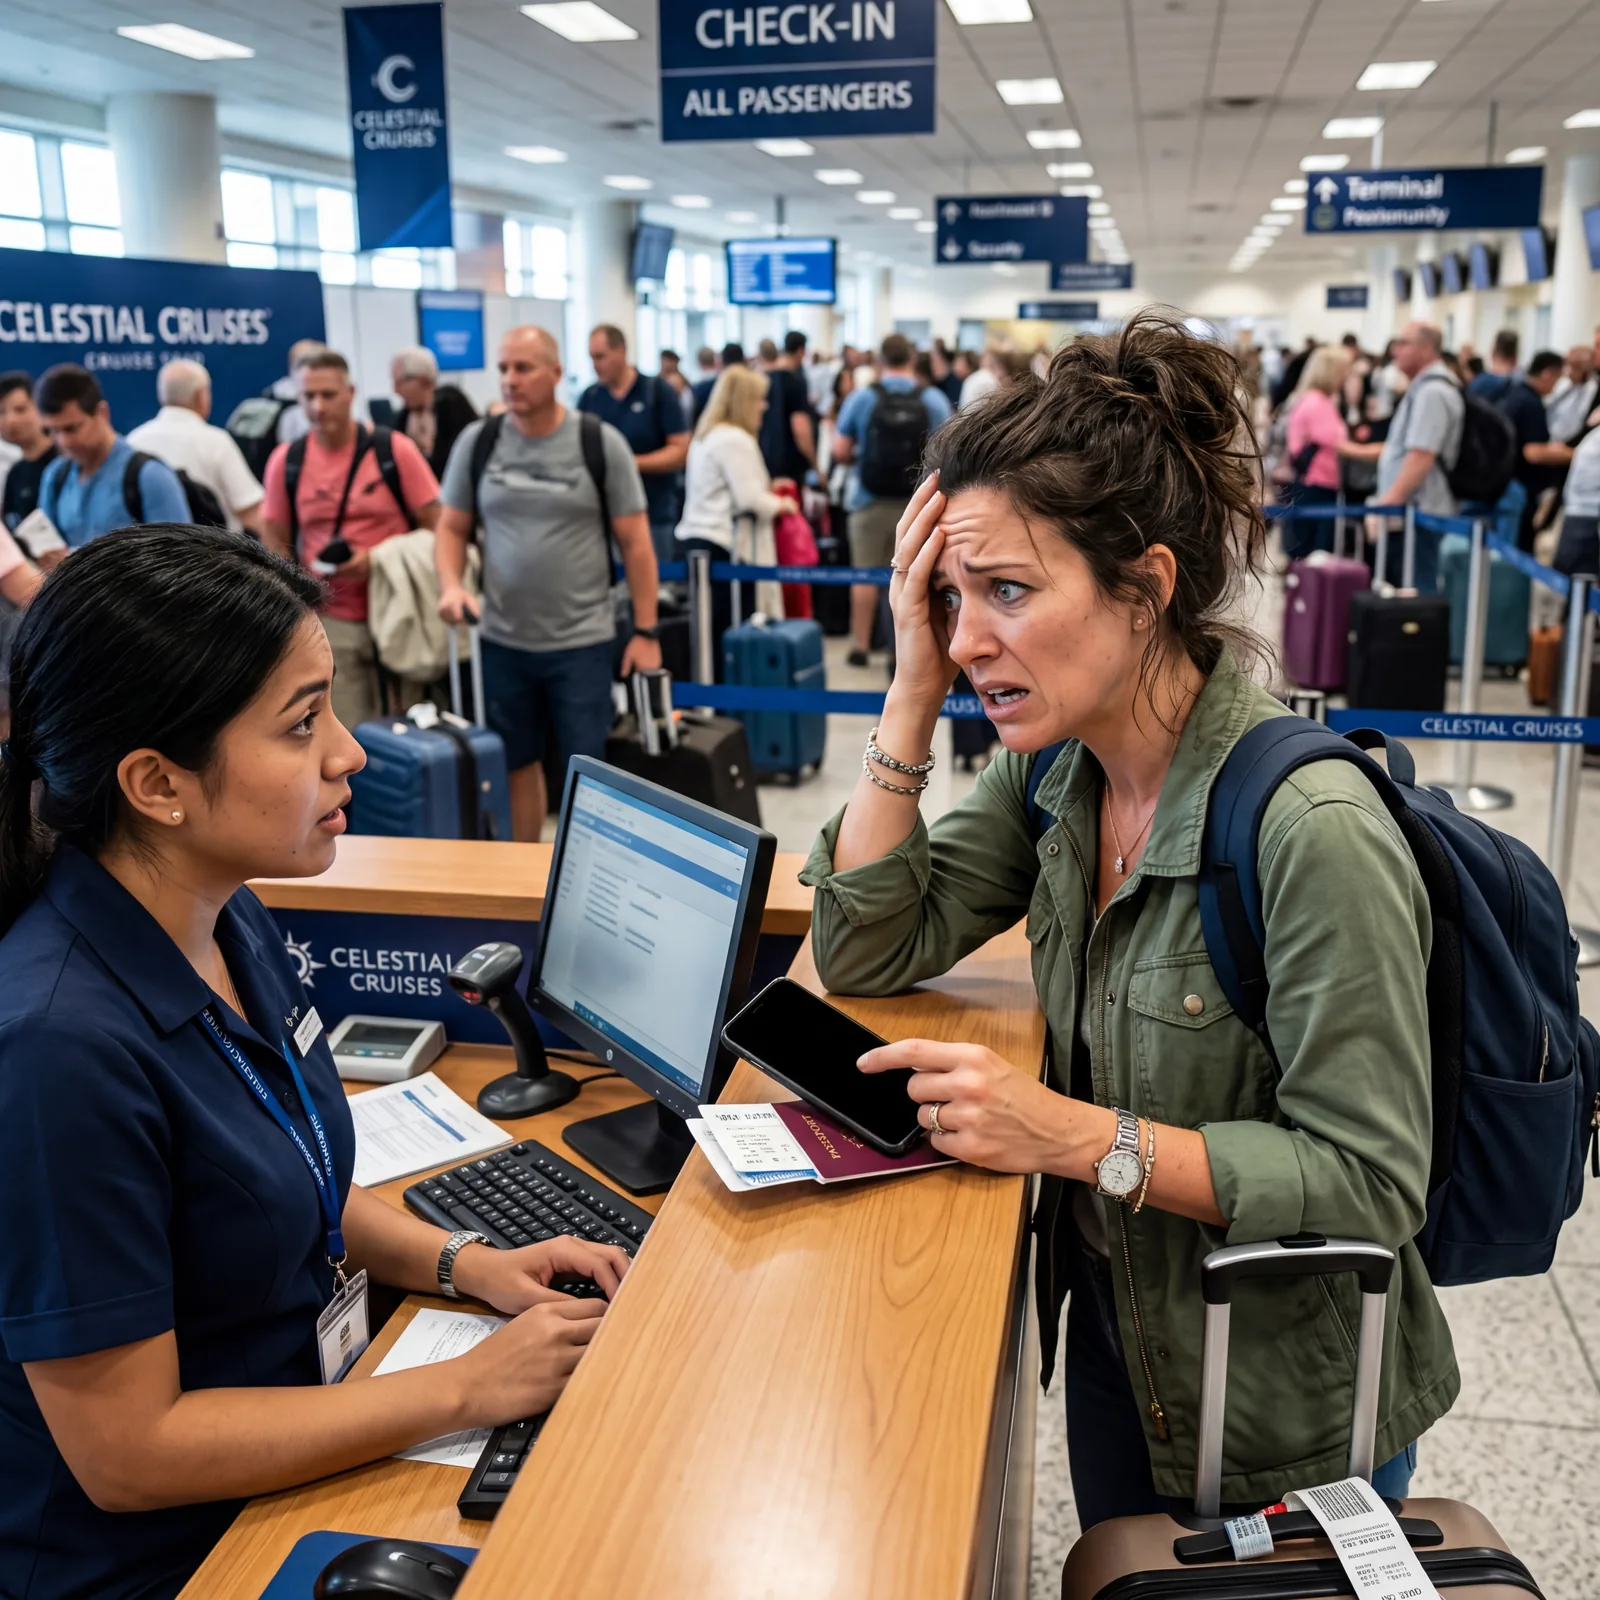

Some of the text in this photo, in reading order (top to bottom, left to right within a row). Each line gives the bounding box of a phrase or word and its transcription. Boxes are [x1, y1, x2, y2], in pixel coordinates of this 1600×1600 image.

[695, 1, 895, 49] CHECK-IN
[683, 80, 913, 117] ALL PASSENGERS
[353, 108, 444, 131] CELESTIAL
[363, 127, 437, 150] CRUISES
[1345, 173, 1444, 201] Terminal
[0, 299, 269, 345] CELESTIAL CRUISES
[1420, 717, 1584, 739] CELESTIAL CRUISES
[350, 972, 442, 997] CRUISES
